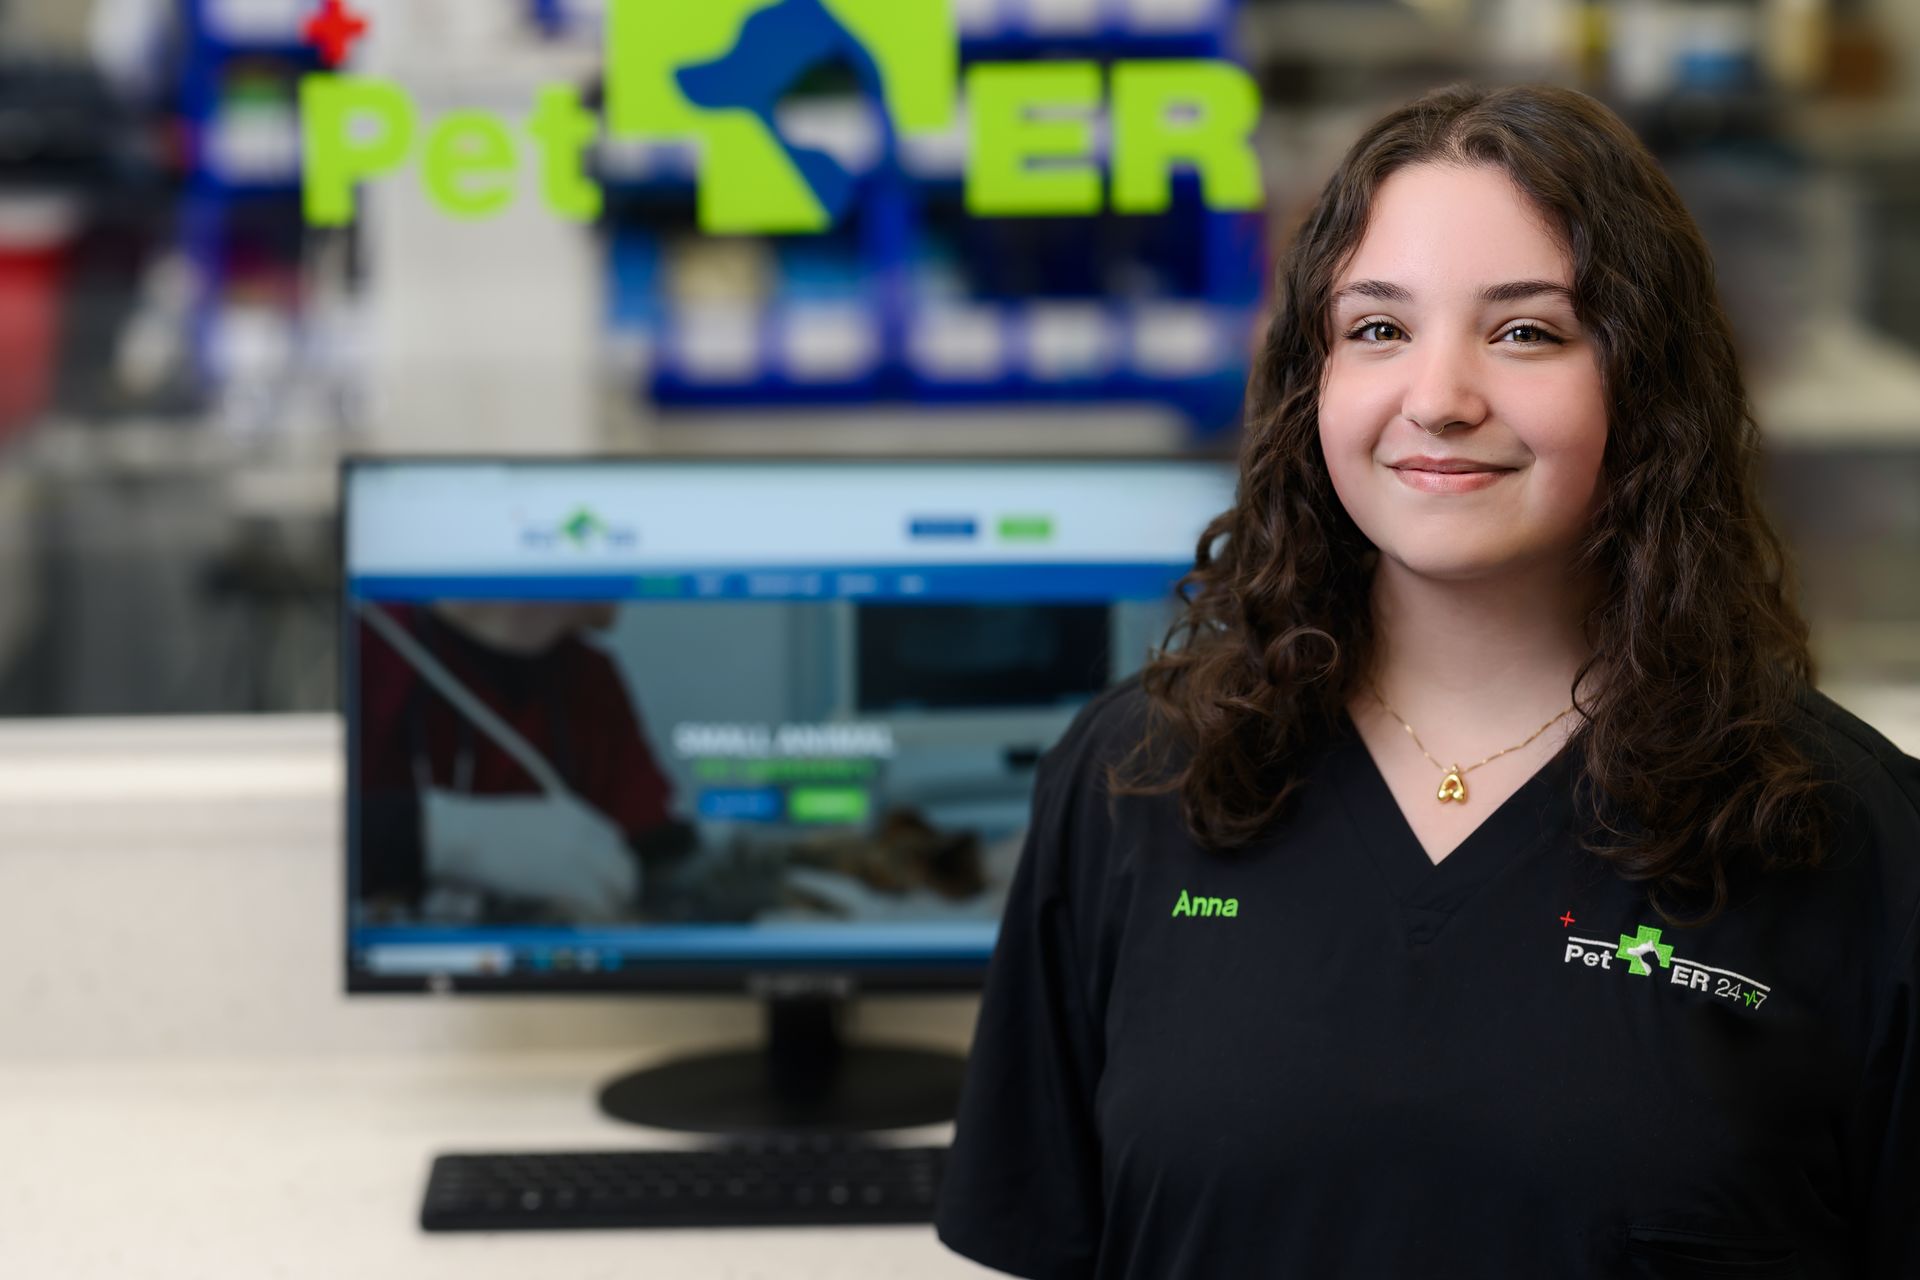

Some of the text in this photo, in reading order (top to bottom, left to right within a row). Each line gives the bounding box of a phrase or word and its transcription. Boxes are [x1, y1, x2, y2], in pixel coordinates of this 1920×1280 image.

[301, 59, 1263, 227] Pet ER
[1171, 889, 1239, 918] Anna
[1564, 944, 1613, 970] Pet
[1670, 965, 1711, 992] ER
